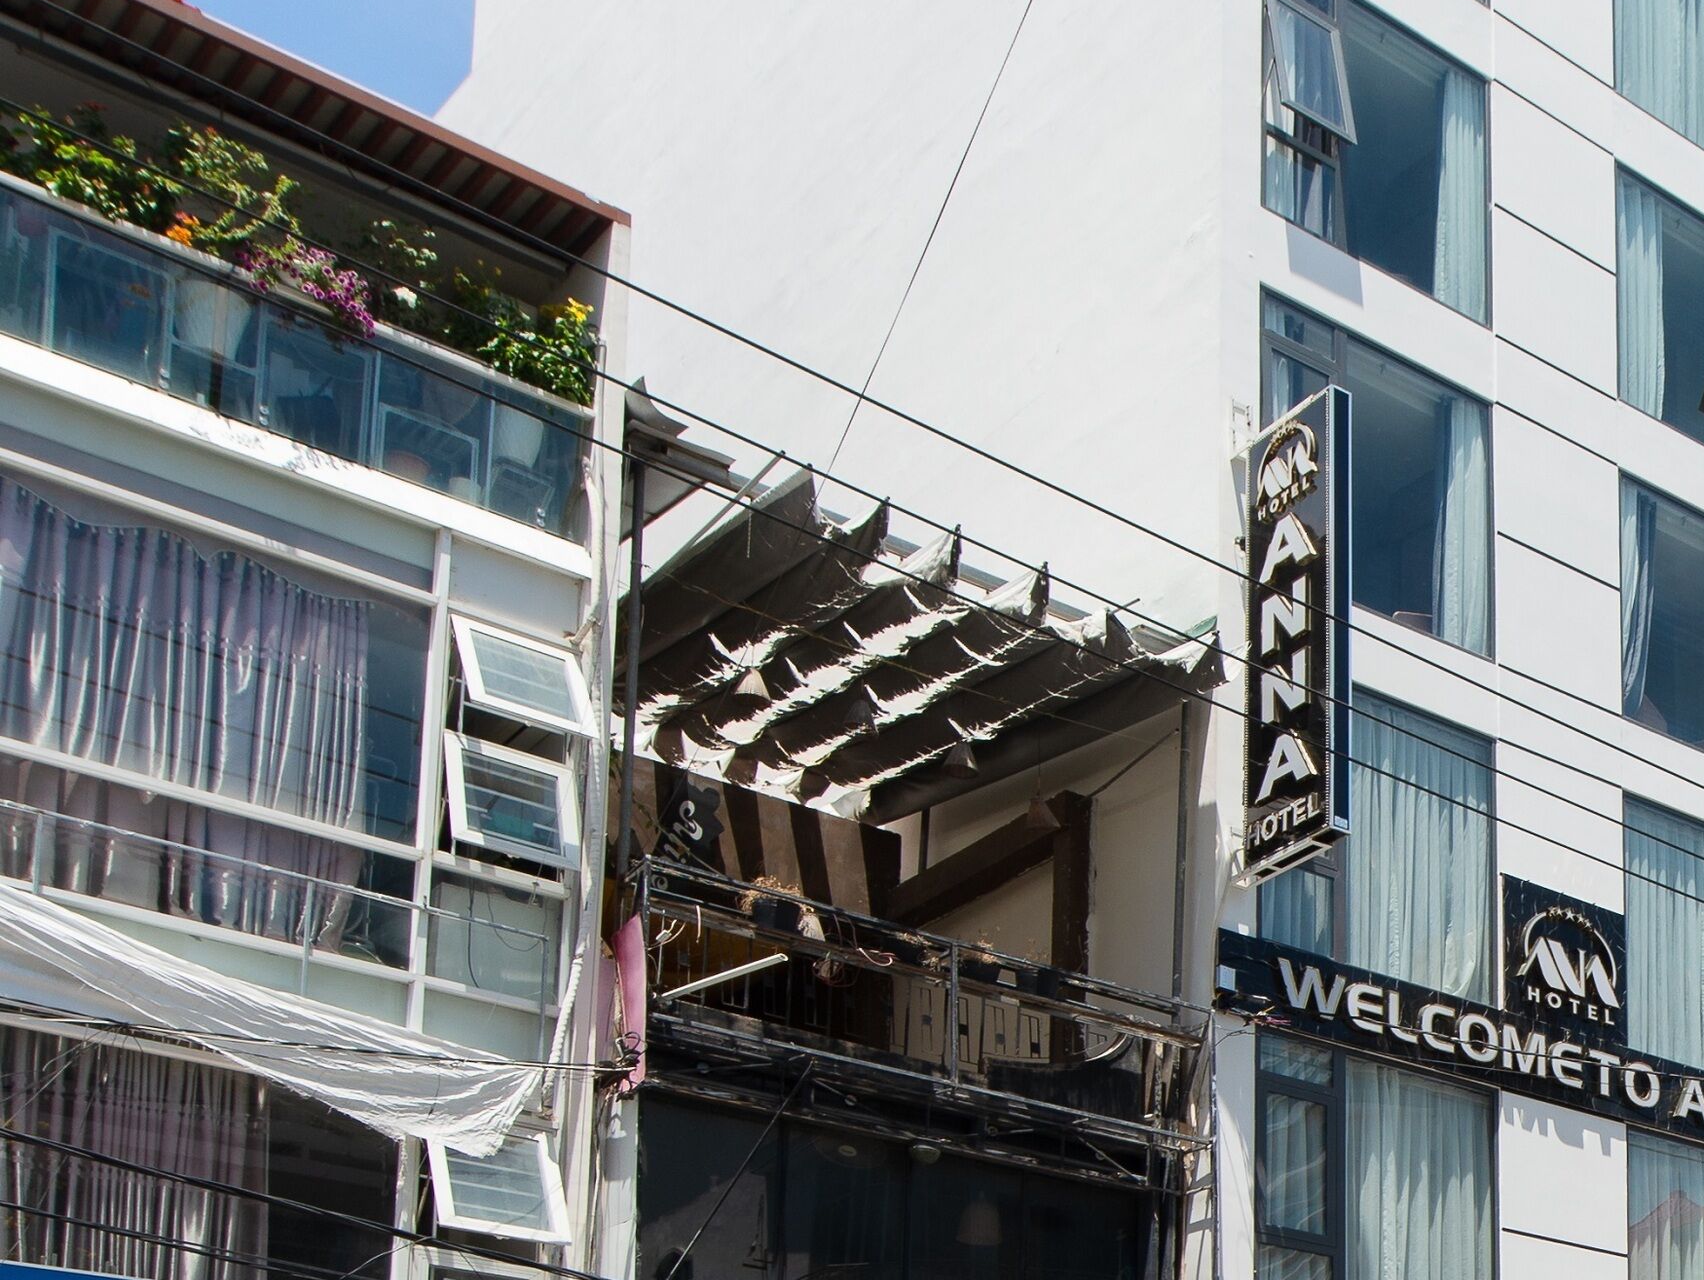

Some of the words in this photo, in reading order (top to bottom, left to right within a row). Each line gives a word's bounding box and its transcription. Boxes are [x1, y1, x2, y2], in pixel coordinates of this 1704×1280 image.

[1258, 476, 1311, 521] HOTEL
[1255, 511, 1318, 806] ANNA
[1248, 791, 1321, 849] HOTEL
[1527, 986, 1616, 1027] HOTEL
